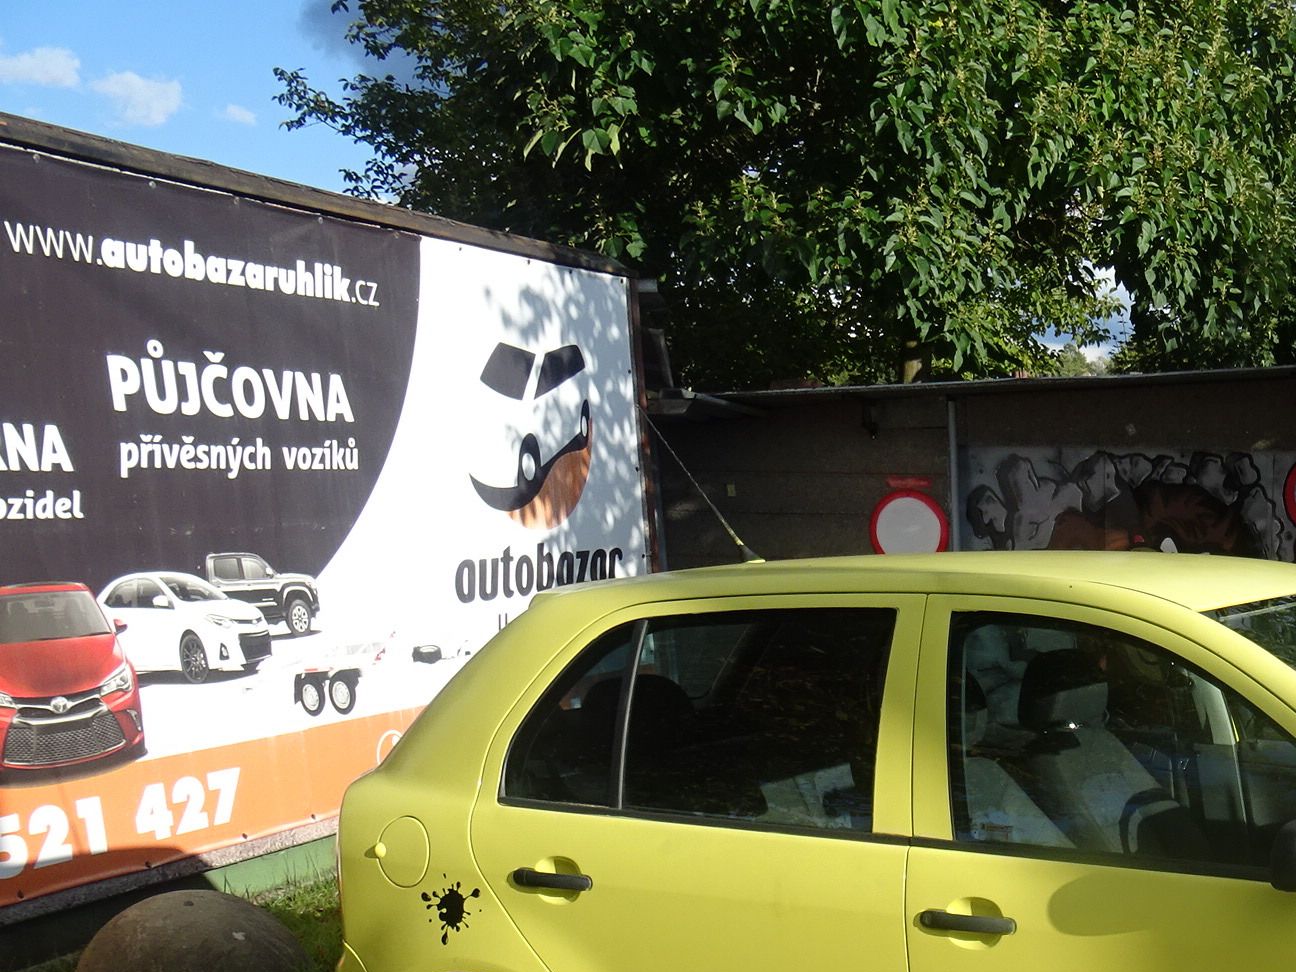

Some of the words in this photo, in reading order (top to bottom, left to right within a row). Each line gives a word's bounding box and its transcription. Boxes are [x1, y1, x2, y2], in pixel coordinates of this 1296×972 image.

[4, 220, 380, 307] www.autobazaruhlik.cz
[106, 339, 355, 422] PŮJČOVNA
[0, 422, 75, 472] NA
[119, 434, 271, 479] přívěsných
[282, 437, 359, 470] vozíků
[0, 796, 109, 879] 521
[136, 767, 241, 841] 427
